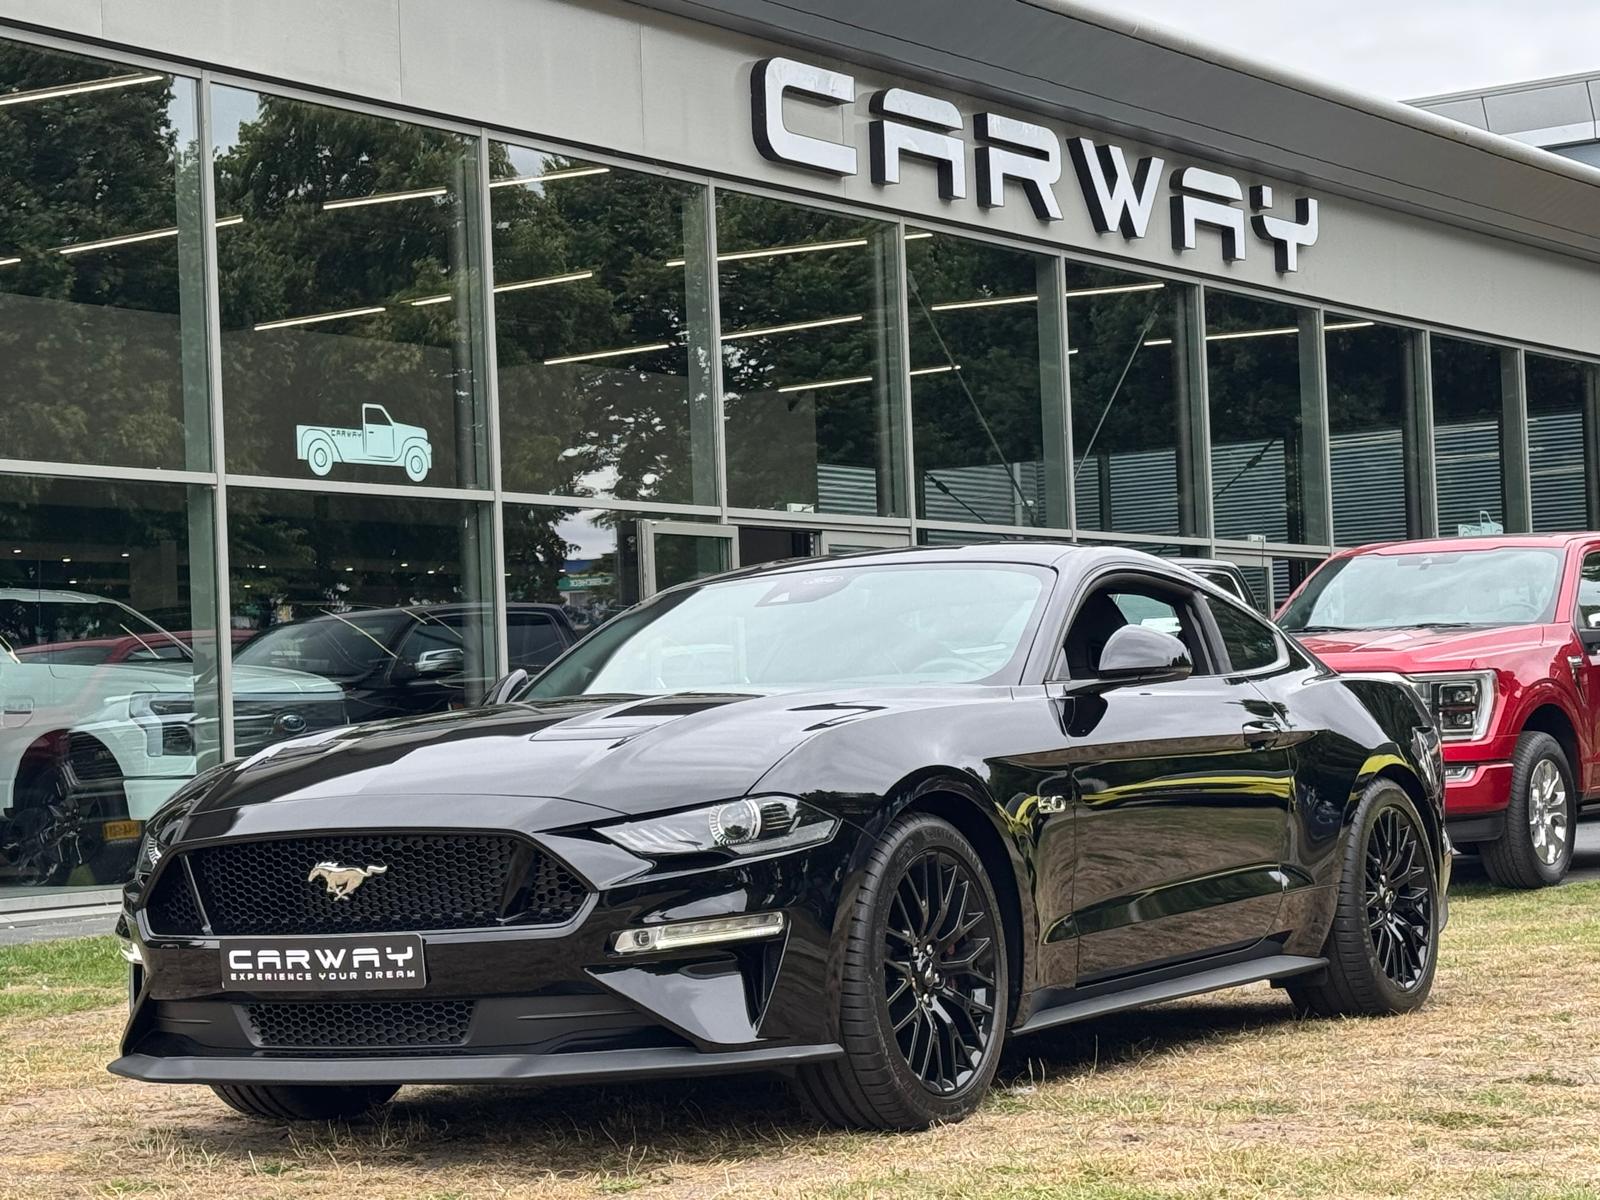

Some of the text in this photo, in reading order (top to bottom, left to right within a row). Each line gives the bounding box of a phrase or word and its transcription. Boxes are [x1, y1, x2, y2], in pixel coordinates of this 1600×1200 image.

[751, 57, 1319, 274] CARWAY
[331, 429, 362, 438] CARWAY
[228, 946, 414, 970] CARWAY
[230, 970, 416, 981] EXPERIENCE YOUR DREAM
